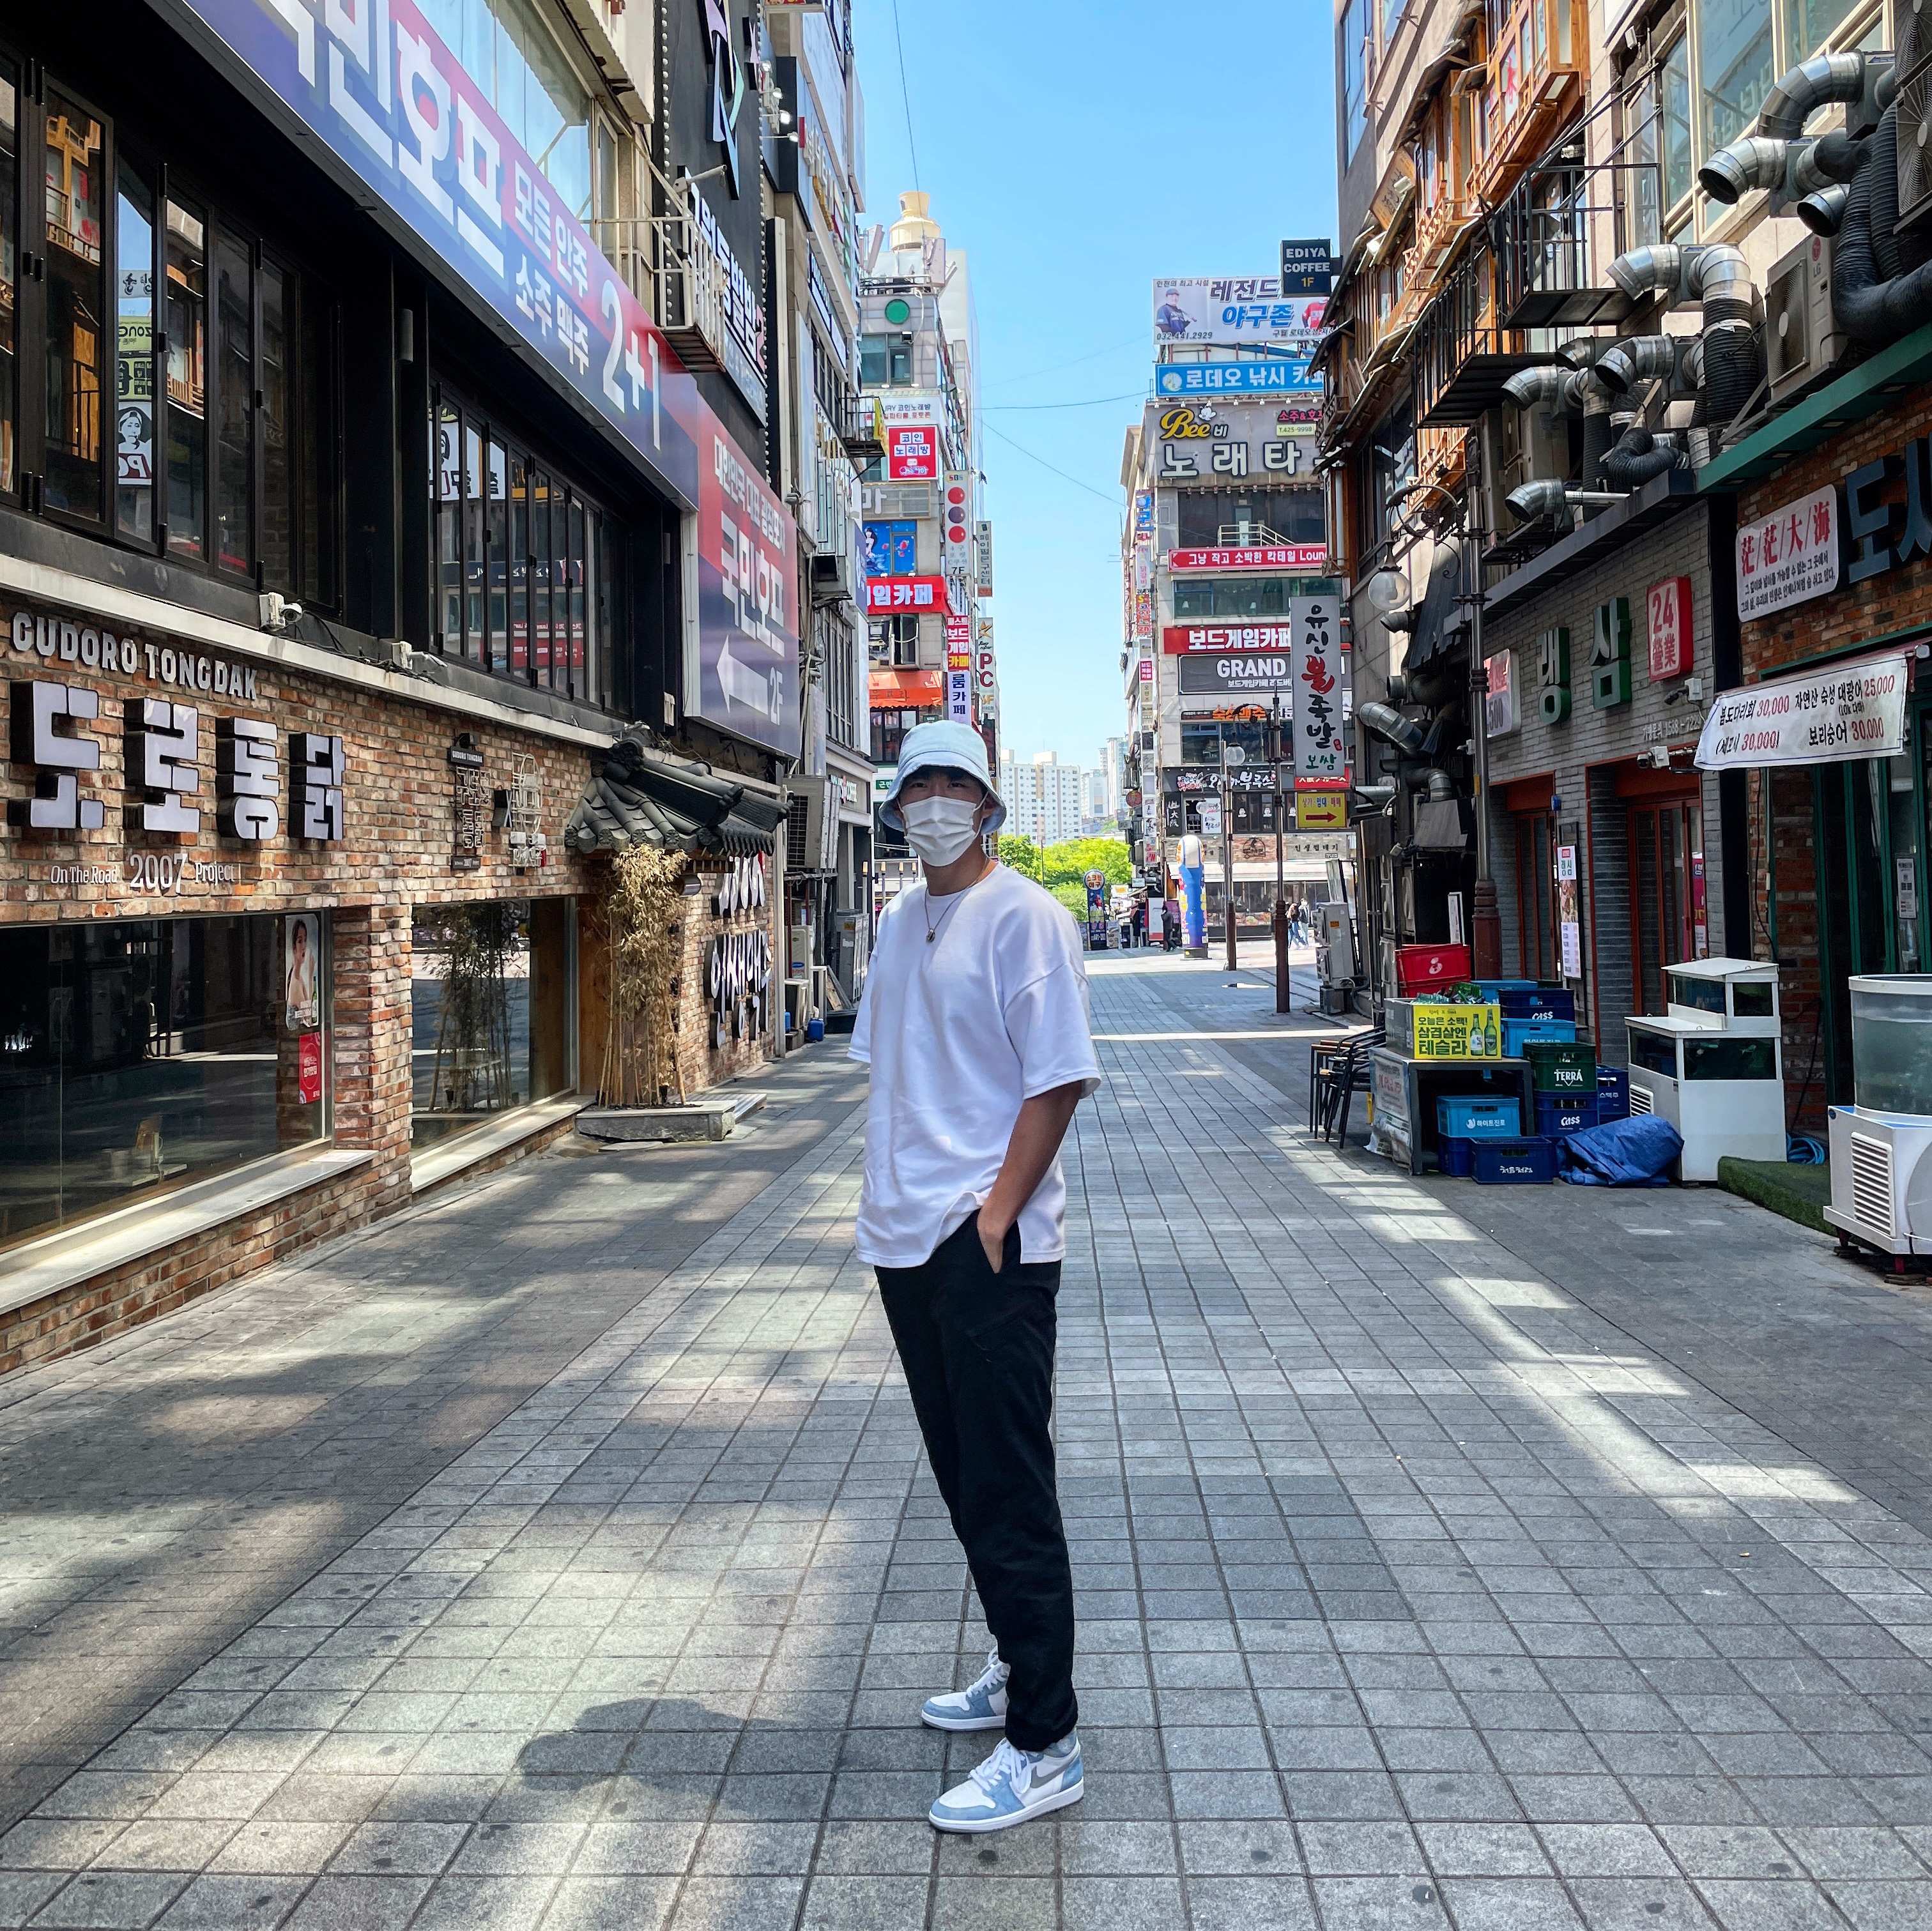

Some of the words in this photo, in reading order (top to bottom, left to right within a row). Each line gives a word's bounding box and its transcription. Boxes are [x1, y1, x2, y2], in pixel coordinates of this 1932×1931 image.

[259, 0, 505, 279] 민호프
[514, 159, 551, 264] 모든
[556, 214, 588, 298] 안주
[1286, 248, 1326, 258] EDIYA
[1284, 263, 1330, 273] COFFEE
[1813, 263, 1821, 275] LG
[1210, 279, 1280, 302] 레전드
[1301, 277, 1314, 287] 1F
[516, 253, 552, 337] 소주
[557, 295, 590, 376] 맥주
[1222, 304, 1294, 329] 야구존
[602, 279, 660, 450] 2+1
[1186, 369, 1241, 388] 로데오
[1250, 367, 1285, 386] 낚시
[1160, 408, 1211, 439] Bee
[1214, 424, 1228, 438] 비
[901, 434, 923, 442] 코인
[896, 446, 929, 455] 노래방
[714, 434, 745, 511] 대한민국
[746, 475, 760, 528] 대표
[1188, 553, 1207, 564] 그냥
[1212, 553, 1229, 564] 작고
[1235, 552, 1262, 563] 소박한
[1268, 551, 1296, 563] 칵테일
[1300, 549, 1326, 561] Loun
[721, 510, 785, 658] 국민호프
[1652, 588, 1673, 634] 24
[947, 629, 969, 640] 보드
[1188, 628, 1290, 650] 보드게임카페
[12, 611, 137, 674] GUDORO
[144, 643, 257, 699] TONGDAK
[948, 642, 969, 654] 게임
[949, 655, 969, 667] 카페
[1217, 659, 1286, 677] GRAND
[1228, 679, 1268, 687] 보드게임카페
[769, 666, 783, 726] 2F
[952, 674, 966, 715] 룸카페
[1795, 687, 1818, 711] 자연산
[1821, 683, 1836, 706] 숙성
[1838, 678, 1863, 703] 대광어
[1864, 675, 1894, 698] 25,000
[1757, 695, 1790, 718] 30,000
[1809, 720, 1848, 746] 보리숭어
[1851, 717, 1884, 742] 30,000
[1305, 754, 1337, 770] 보쌈
[1316, 797, 1326, 807] 임대
[50, 866, 68, 884] On
[69, 866, 89, 884] The
[90, 866, 119, 885] Road
[129, 853, 188, 894] 2007
[194, 861, 236, 885] Project
[1418, 1017, 1445, 1025] 오늘은
[1447, 1017, 1468, 1025] 소맥!
[1418, 1027, 1467, 1039] 삼겹살엔
[1419, 1039, 1468, 1055] 테슬라
[1554, 1069, 1583, 1082] TERRA
[1499, 1165, 1533, 1174] 처음처럼
